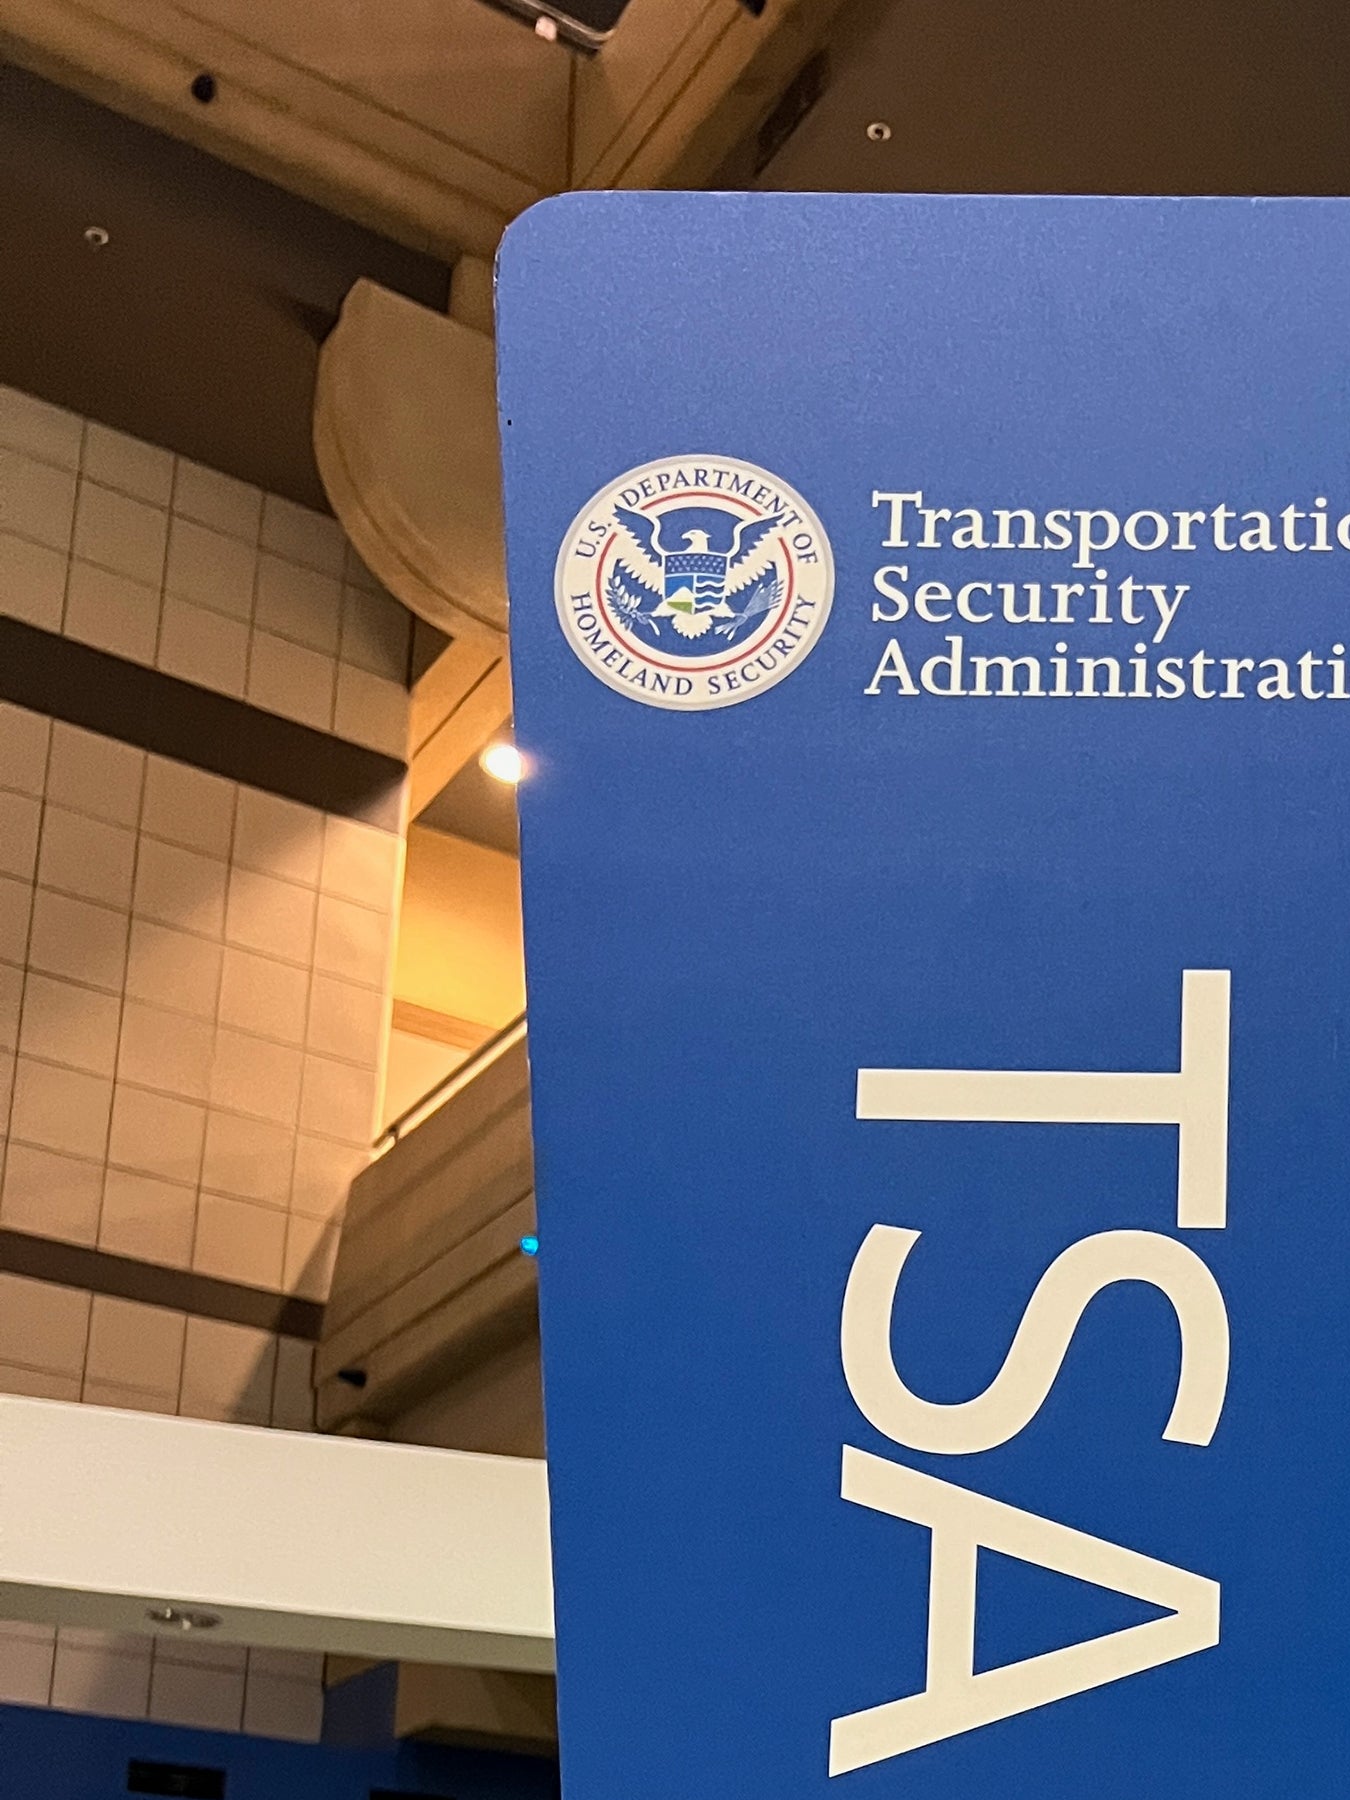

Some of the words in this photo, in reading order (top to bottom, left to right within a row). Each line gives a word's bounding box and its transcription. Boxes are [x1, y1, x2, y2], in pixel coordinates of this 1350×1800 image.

[575, 518, 612, 560] U.S.
[619, 467, 803, 529] DEPARTMENT
[792, 531, 819, 566] OF
[570, 591, 694, 696] HOMELAND
[707, 593, 817, 697] SECURITY
[872, 565, 1191, 644] Security
[829, 968, 1232, 1779] TSA
